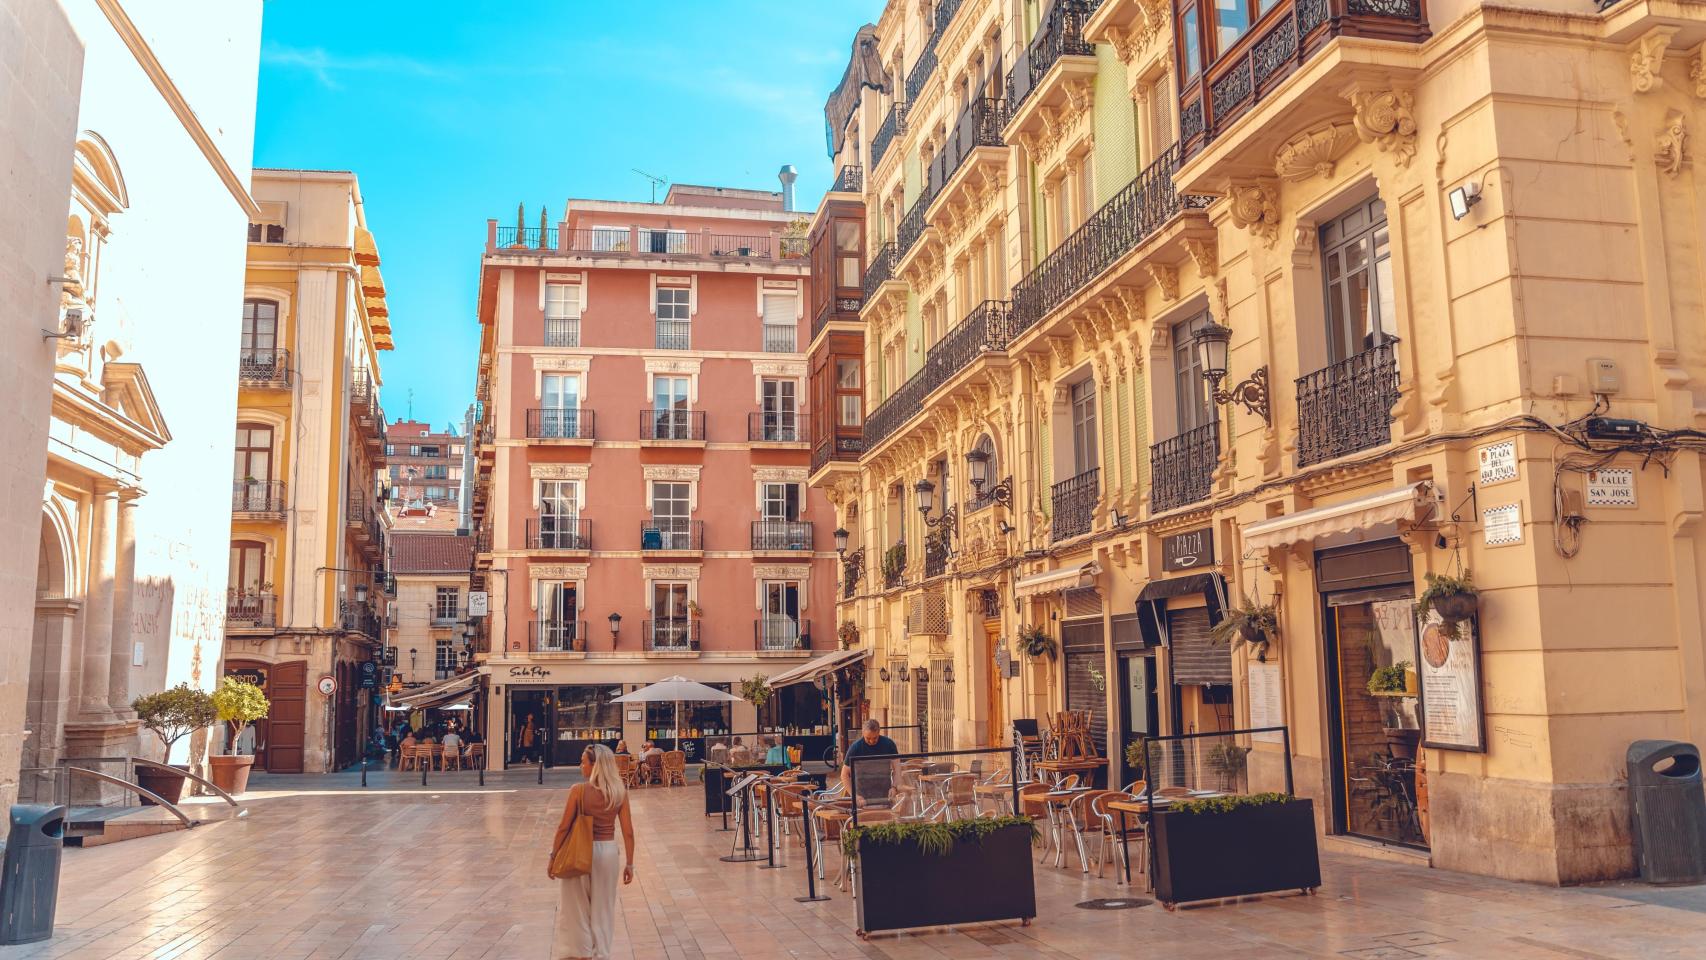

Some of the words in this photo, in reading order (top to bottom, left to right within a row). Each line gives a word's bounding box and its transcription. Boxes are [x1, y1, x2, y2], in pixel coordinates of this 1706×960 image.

[1490, 449, 1510, 460] PLAZA
[1491, 459, 1502, 467] DEL
[1601, 476, 1628, 485] CALLE
[1590, 488, 1606, 497] SAN
[1611, 488, 1631, 497] JOSE
